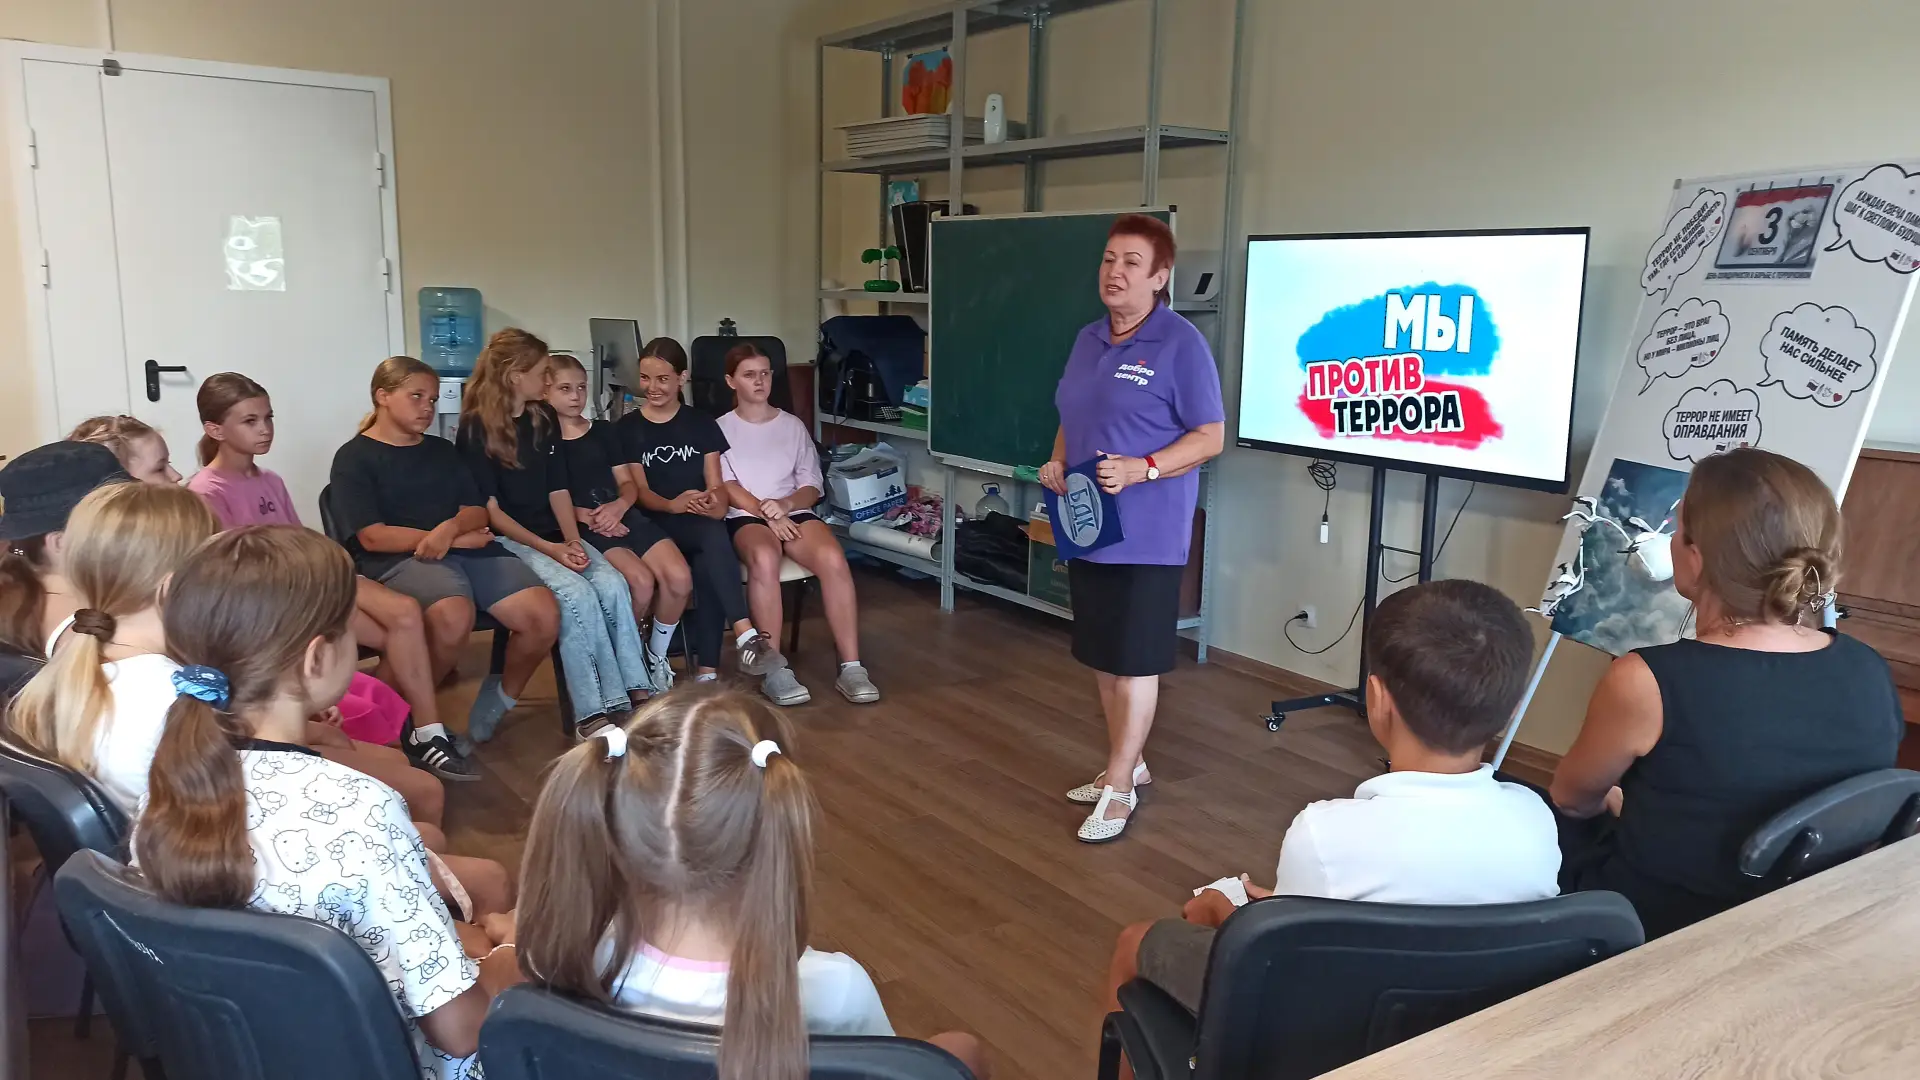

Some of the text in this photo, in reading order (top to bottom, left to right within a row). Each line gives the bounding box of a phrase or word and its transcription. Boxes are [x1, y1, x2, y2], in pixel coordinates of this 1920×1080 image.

[1855, 190, 1886, 211] КАЖДАЯ
[1883, 202, 1906, 220] СВЕЧА
[1857, 207, 1867, 218] К
[1863, 210, 1900, 232] СВЕТЛОМУ
[1651, 201, 1709, 267] ТЕРРОР НЕ ПОБЕДИТ
[1758, 207, 1783, 244] 3
[1383, 293, 1475, 353] МЫ
[1657, 326, 1678, 338] ТЕРРОР
[1696, 316, 1711, 327] ВРАГ
[1666, 336, 1678, 345] БЕЗ
[1780, 326, 1862, 373] ПАМЯТЬ ДЕЛАЕТ
[1118, 364, 1155, 376] добро
[1307, 355, 1423, 398] ПРОТИВ
[1779, 341, 1847, 383] НАС СИЛЬНЕЕ
[1114, 372, 1148, 385] центр
[1332, 393, 1463, 433] ТЕРРОРА
[1676, 410, 1753, 422] ТЕРРОР НЕ ИМЕЕТ
[1673, 424, 1748, 440] ОПРАВДАНИЯ
[855, 506, 881, 519] OFFICE
[883, 498, 905, 509] PAPER
[1070, 487, 1095, 532] БДК
